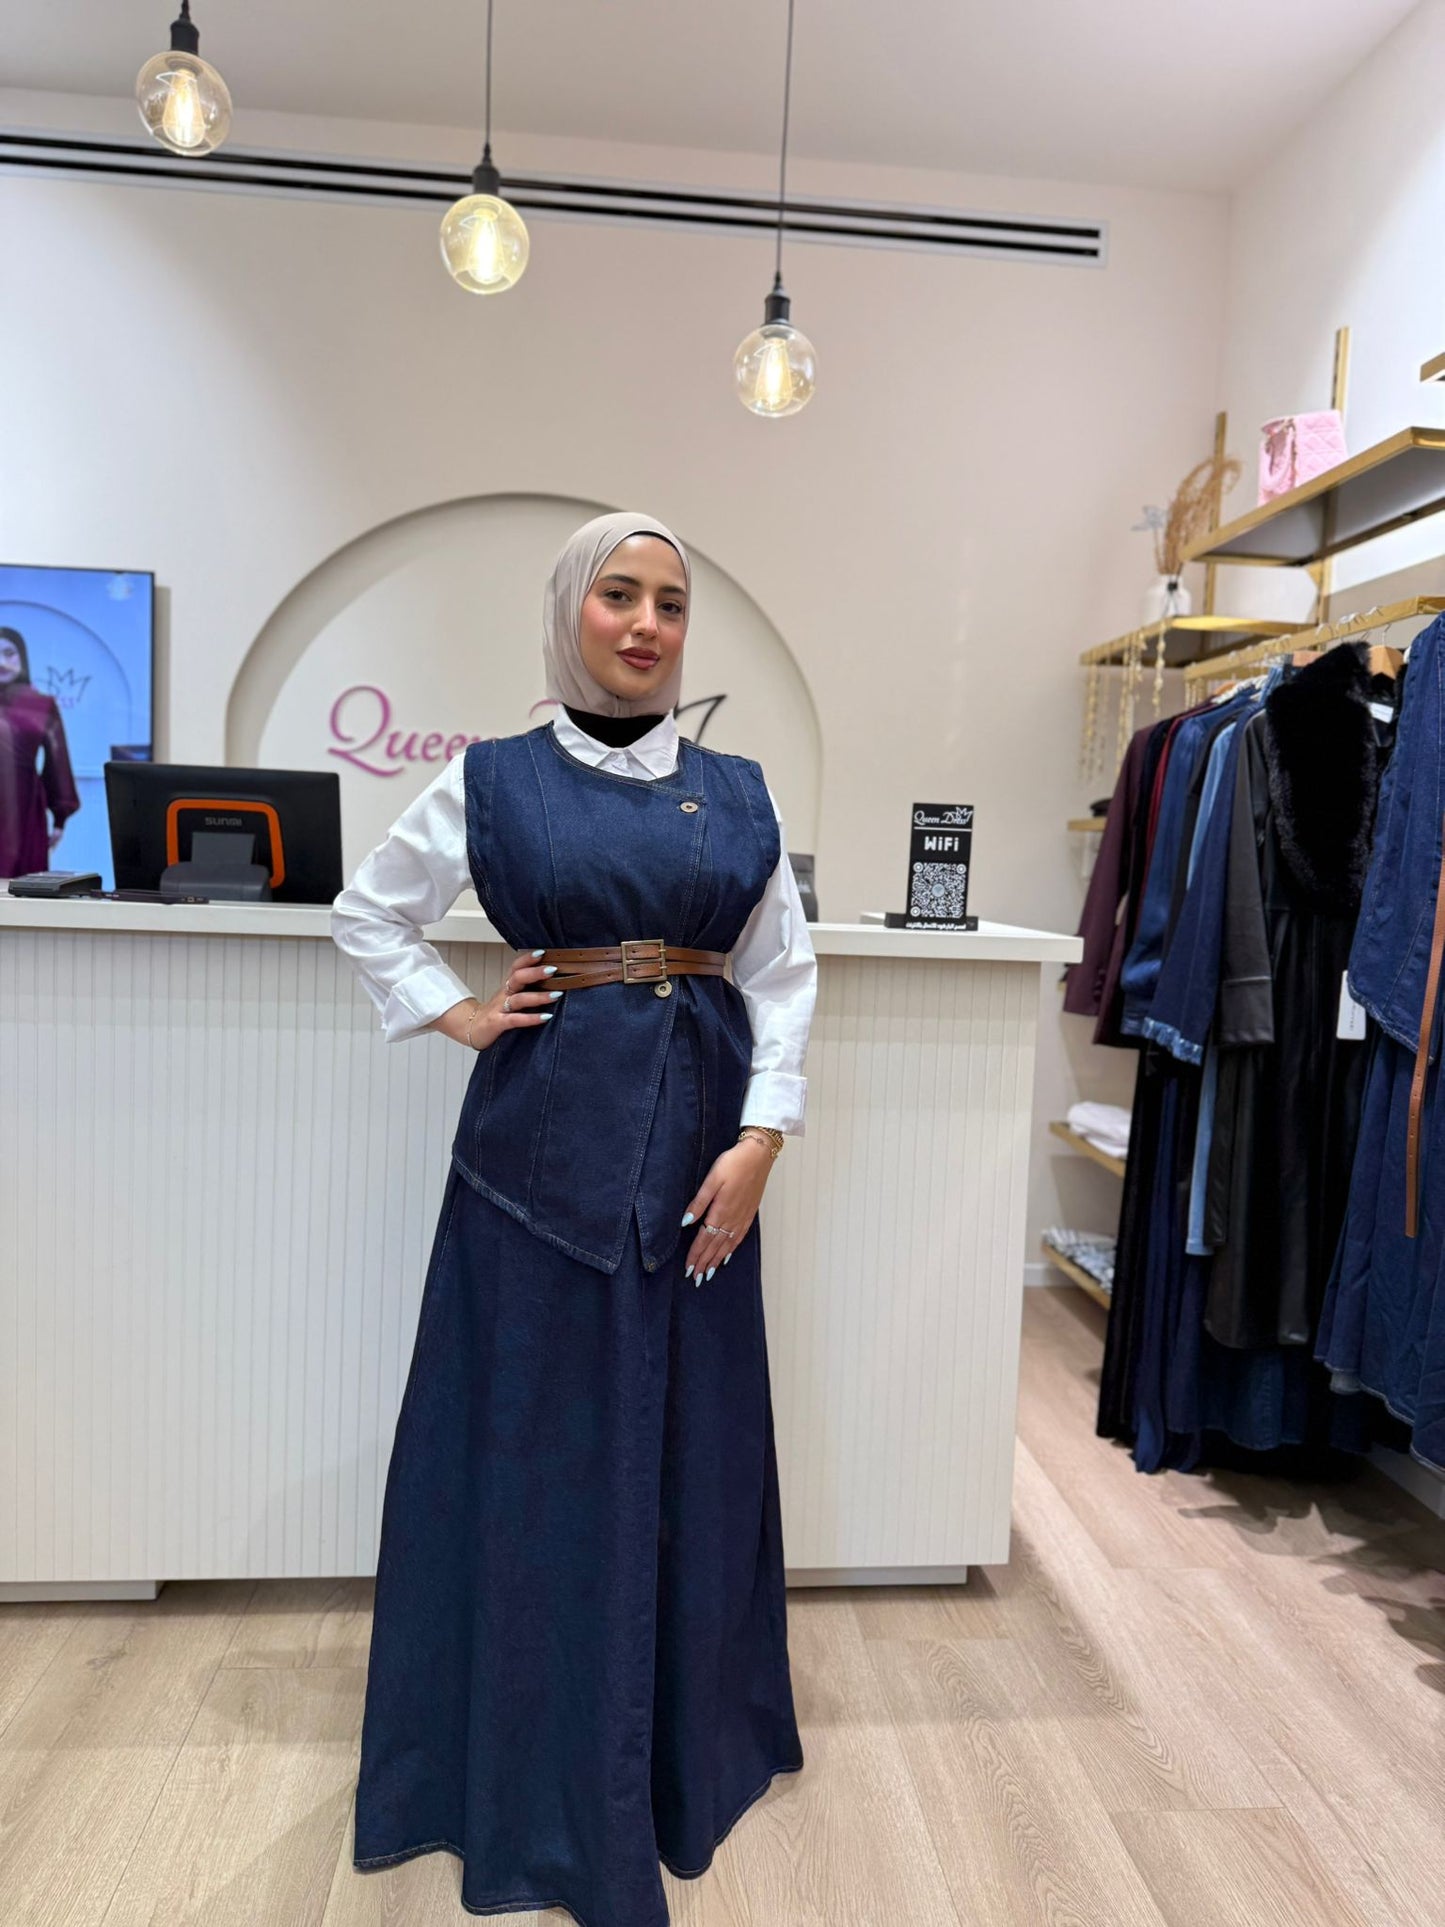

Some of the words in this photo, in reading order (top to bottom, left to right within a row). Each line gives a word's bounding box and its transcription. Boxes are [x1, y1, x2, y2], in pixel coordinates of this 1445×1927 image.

[328, 685, 496, 778] Quee
[913, 810, 941, 826] Queen
[924, 836, 960, 852] WiFi
